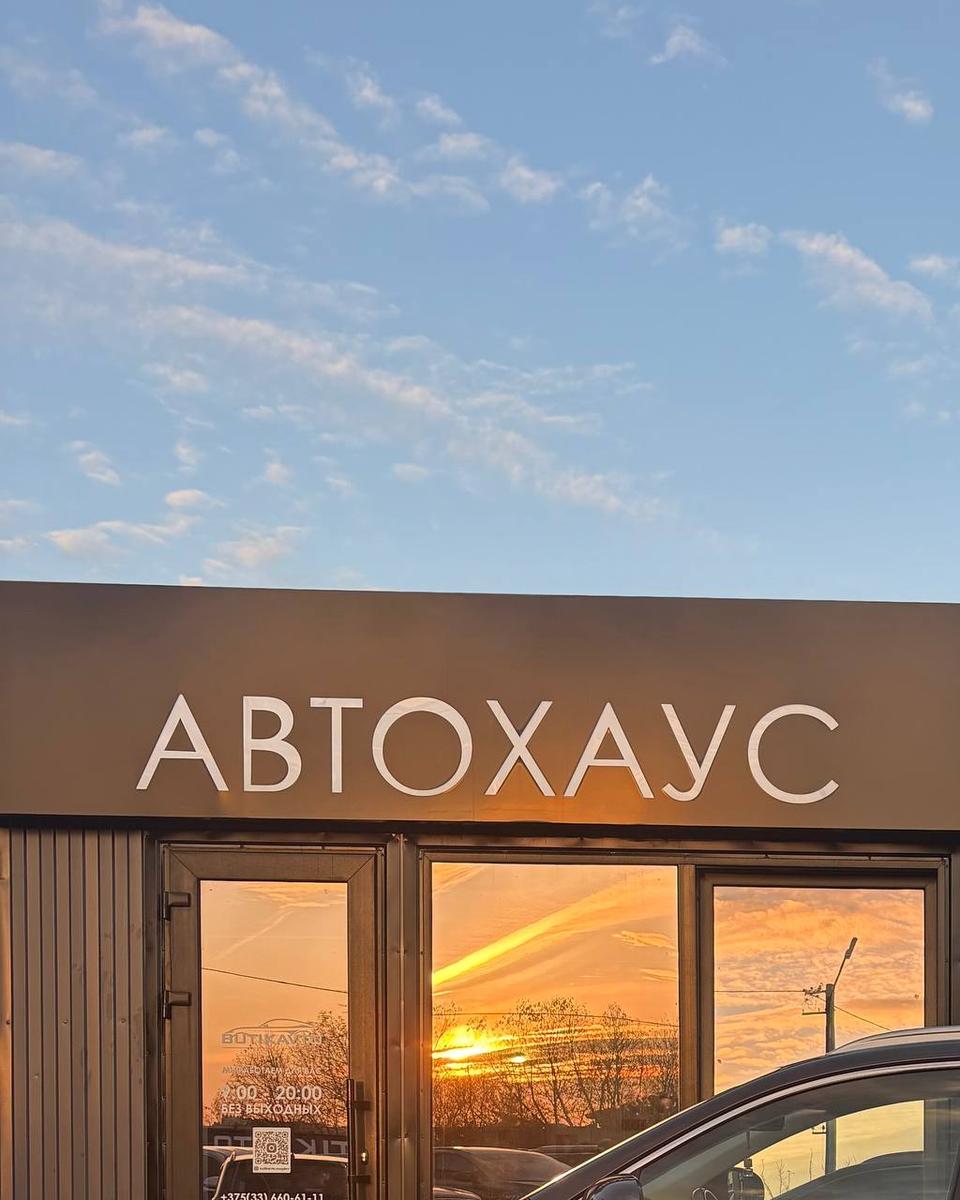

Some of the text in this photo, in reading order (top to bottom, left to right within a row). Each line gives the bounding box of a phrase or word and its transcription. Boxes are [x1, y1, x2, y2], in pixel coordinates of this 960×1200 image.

[136, 692, 840, 806] АВТОХАУС
[276, 1085, 322, 1100] 20:00
[221, 1103, 322, 1116] БЕЗ ВЫХОДНЫХ
